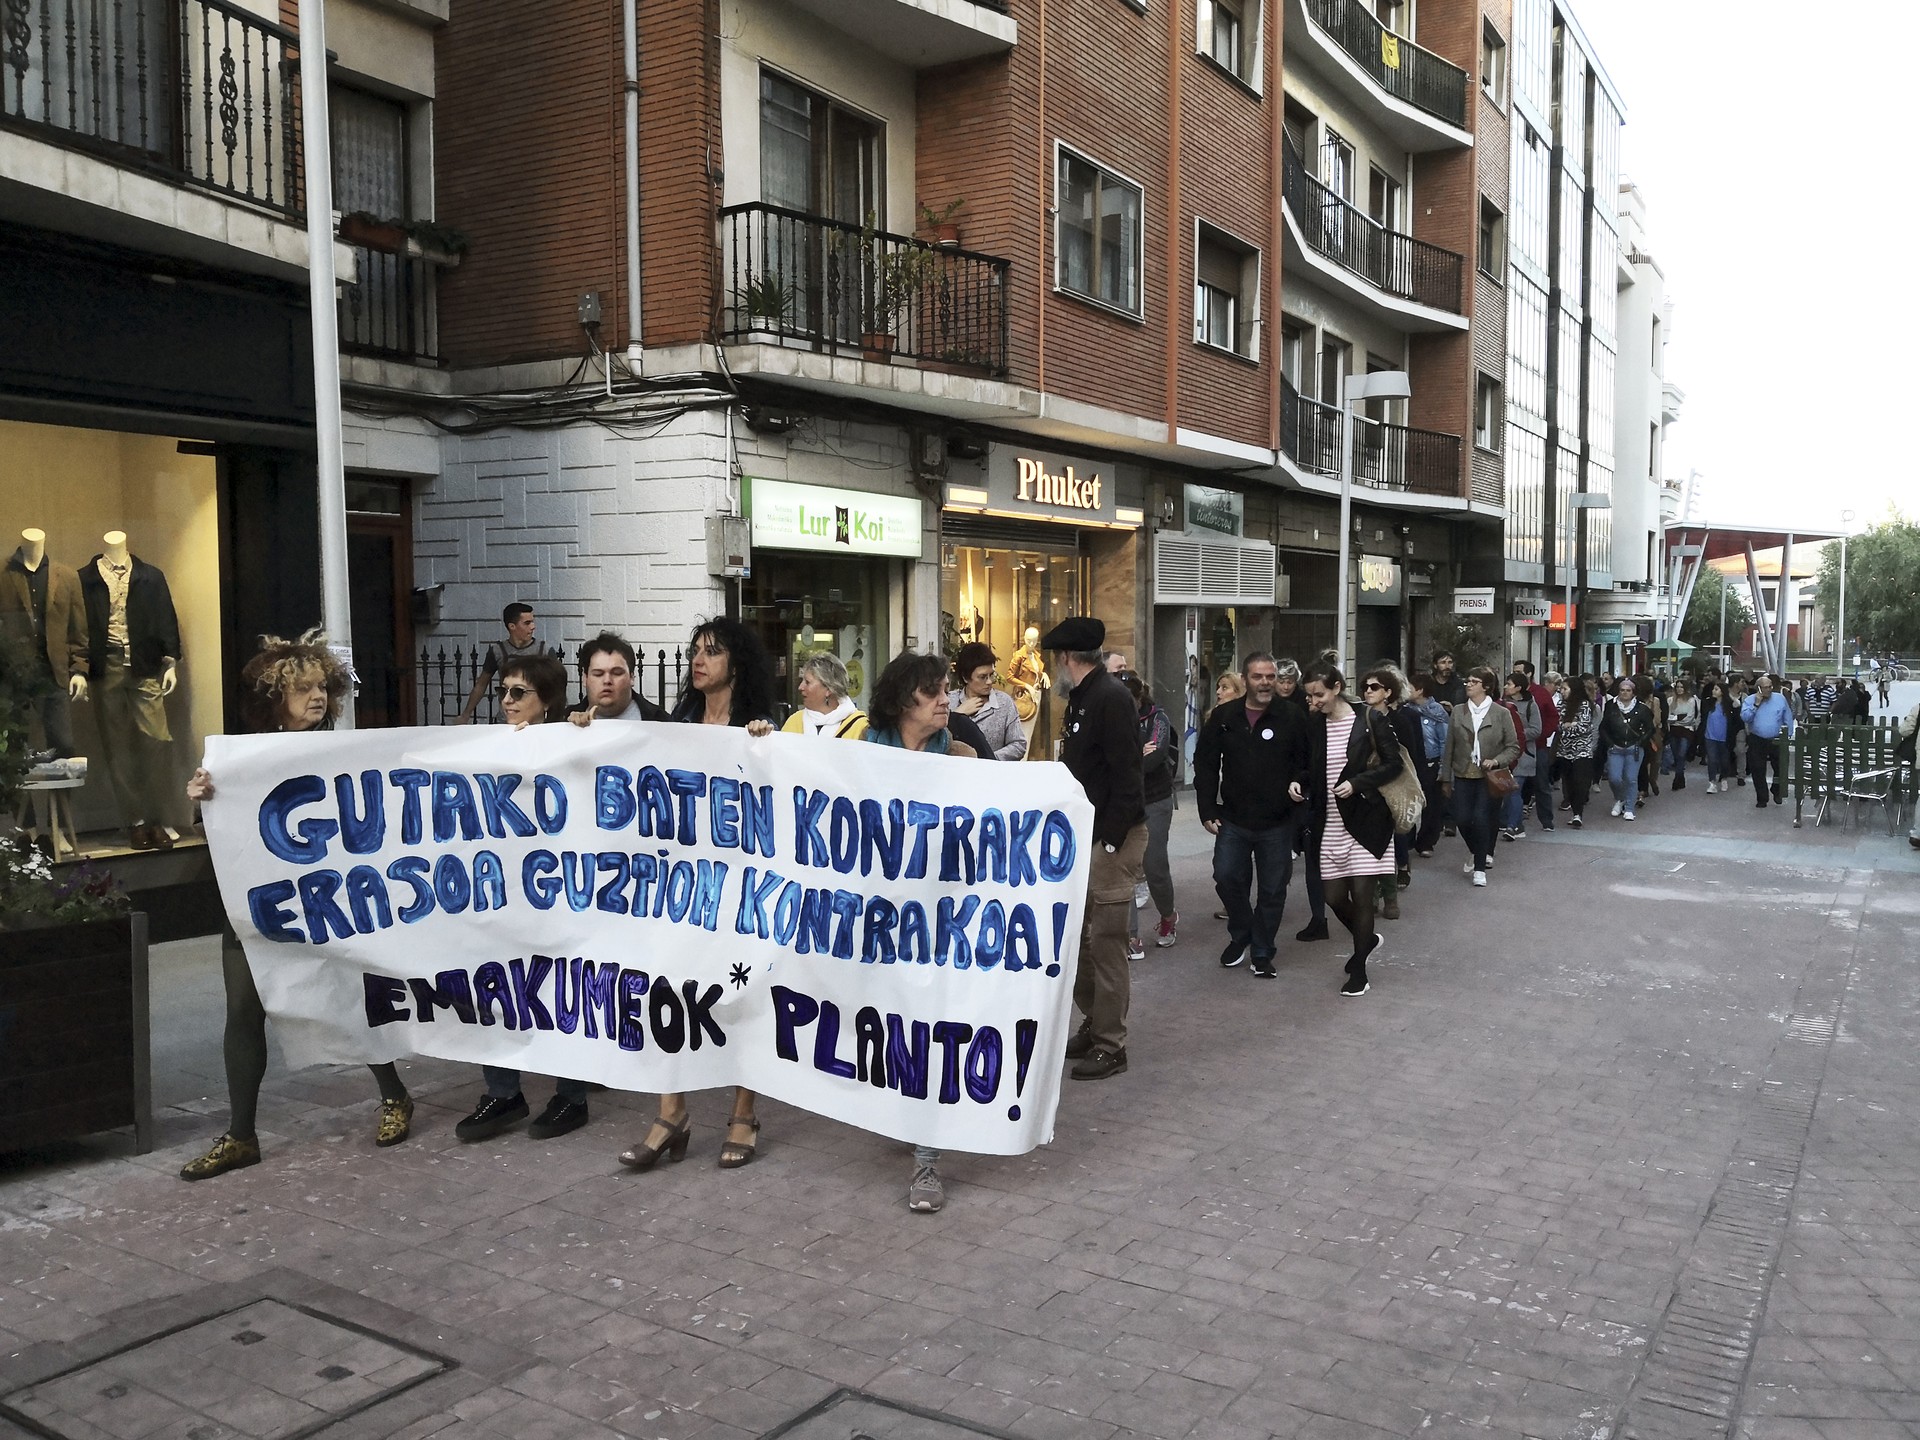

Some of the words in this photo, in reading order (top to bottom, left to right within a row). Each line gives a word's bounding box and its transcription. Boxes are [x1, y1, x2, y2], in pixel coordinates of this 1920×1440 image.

[1015, 457, 1102, 510] Phuket
[799, 504, 831, 537] Lur
[854, 510, 884, 541] Koi
[1459, 599, 1488, 608] PRENSA
[1516, 604, 1547, 618] Ruby
[258, 768, 568, 865] GUTAKO
[595, 765, 776, 859] BATEN
[793, 785, 1077, 888] KONTRAKO
[247, 849, 508, 945] ERASOA
[735, 866, 1069, 978] KONTRAKOA!
[770, 985, 1038, 1122] PLANTO!
